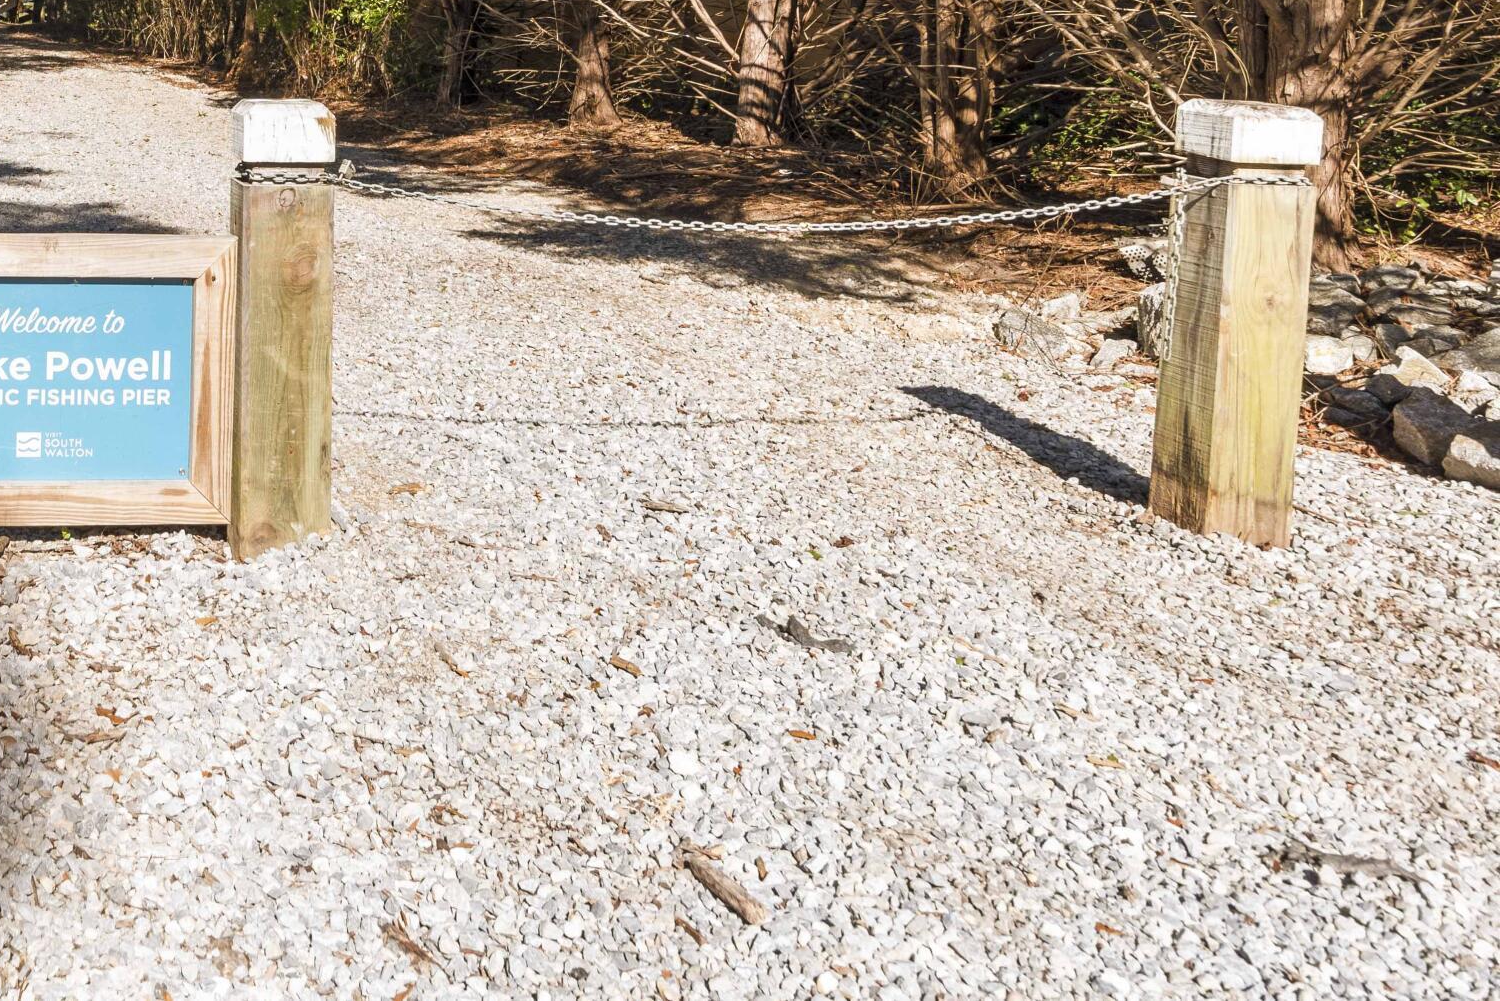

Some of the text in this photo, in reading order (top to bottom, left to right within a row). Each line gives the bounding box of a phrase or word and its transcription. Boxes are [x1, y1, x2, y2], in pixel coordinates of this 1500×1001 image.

[102, 309, 125, 334] to
[46, 350, 172, 381] Powell
[26, 388, 116, 406] FISHING
[122, 388, 171, 406] PIER
[44, 439, 83, 448] SOUTH
[44, 448, 94, 458] WALTON
